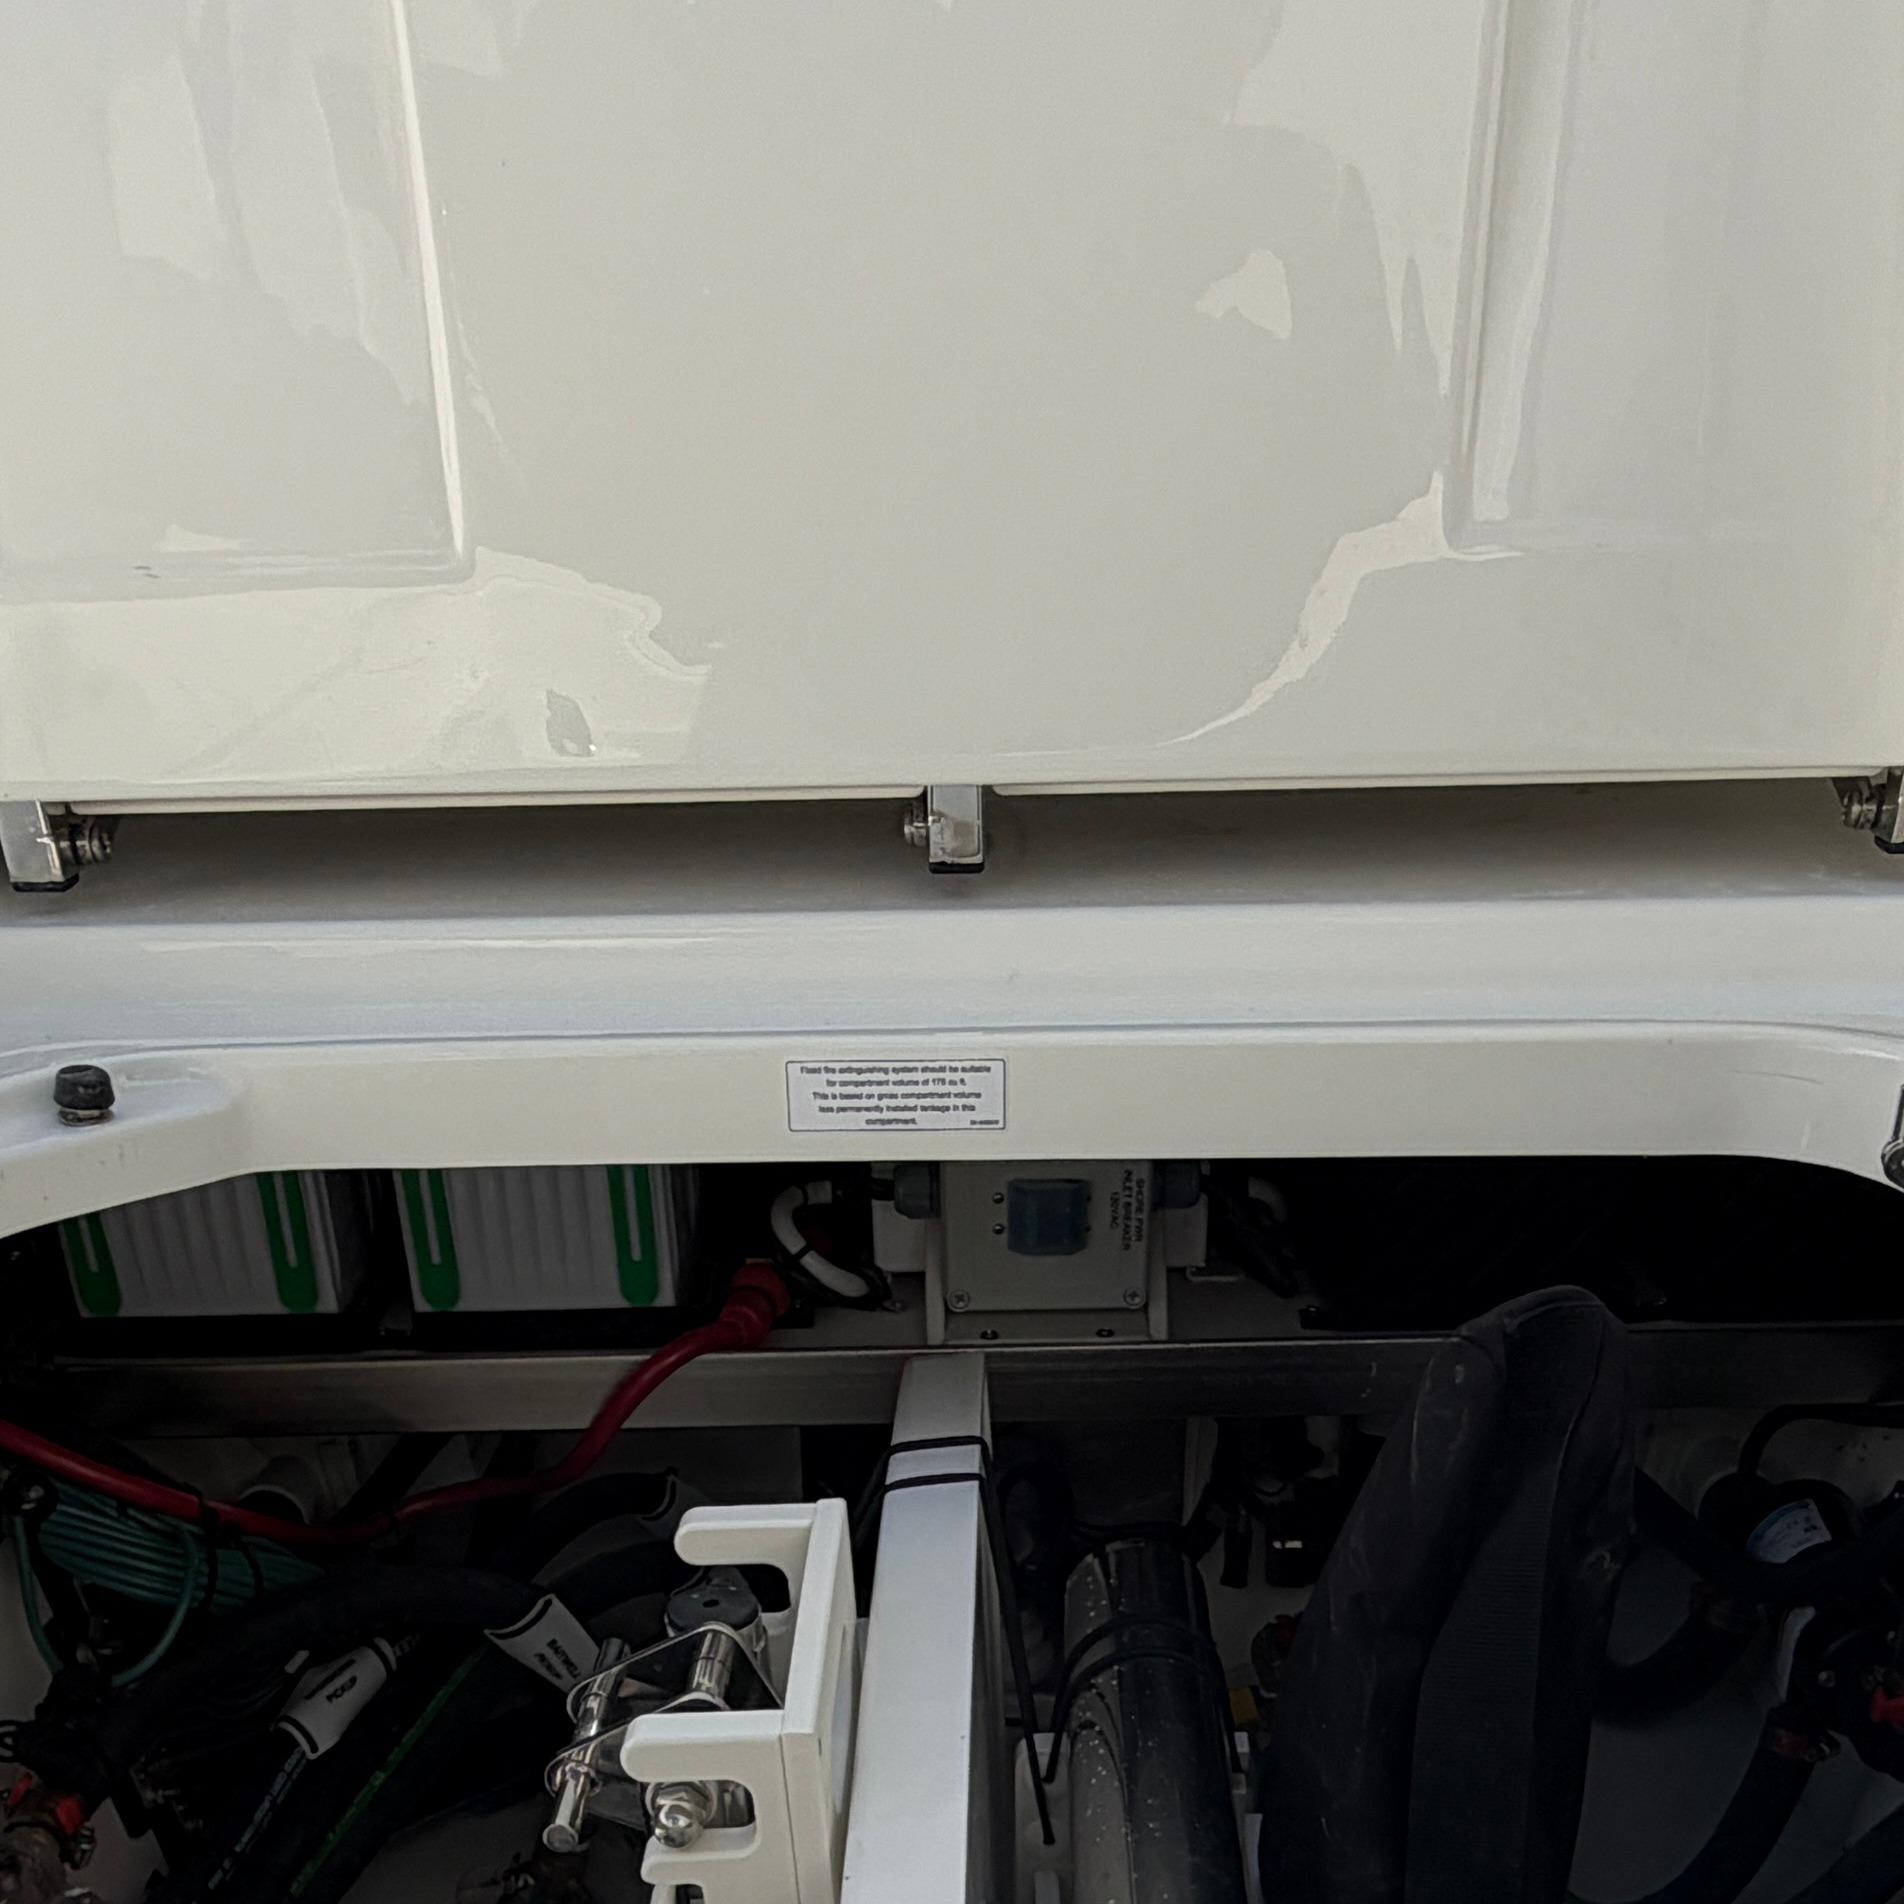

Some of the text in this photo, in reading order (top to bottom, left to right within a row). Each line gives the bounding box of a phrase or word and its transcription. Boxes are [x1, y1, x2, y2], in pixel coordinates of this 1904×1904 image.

[838, 1066, 890, 1076] extinguishing
[891, 1066, 919, 1075] system
[948, 1065, 960, 1073] be
[838, 1079, 890, 1088] compartment
[891, 1079, 920, 1087] volume
[812, 1091, 830, 1100] This
